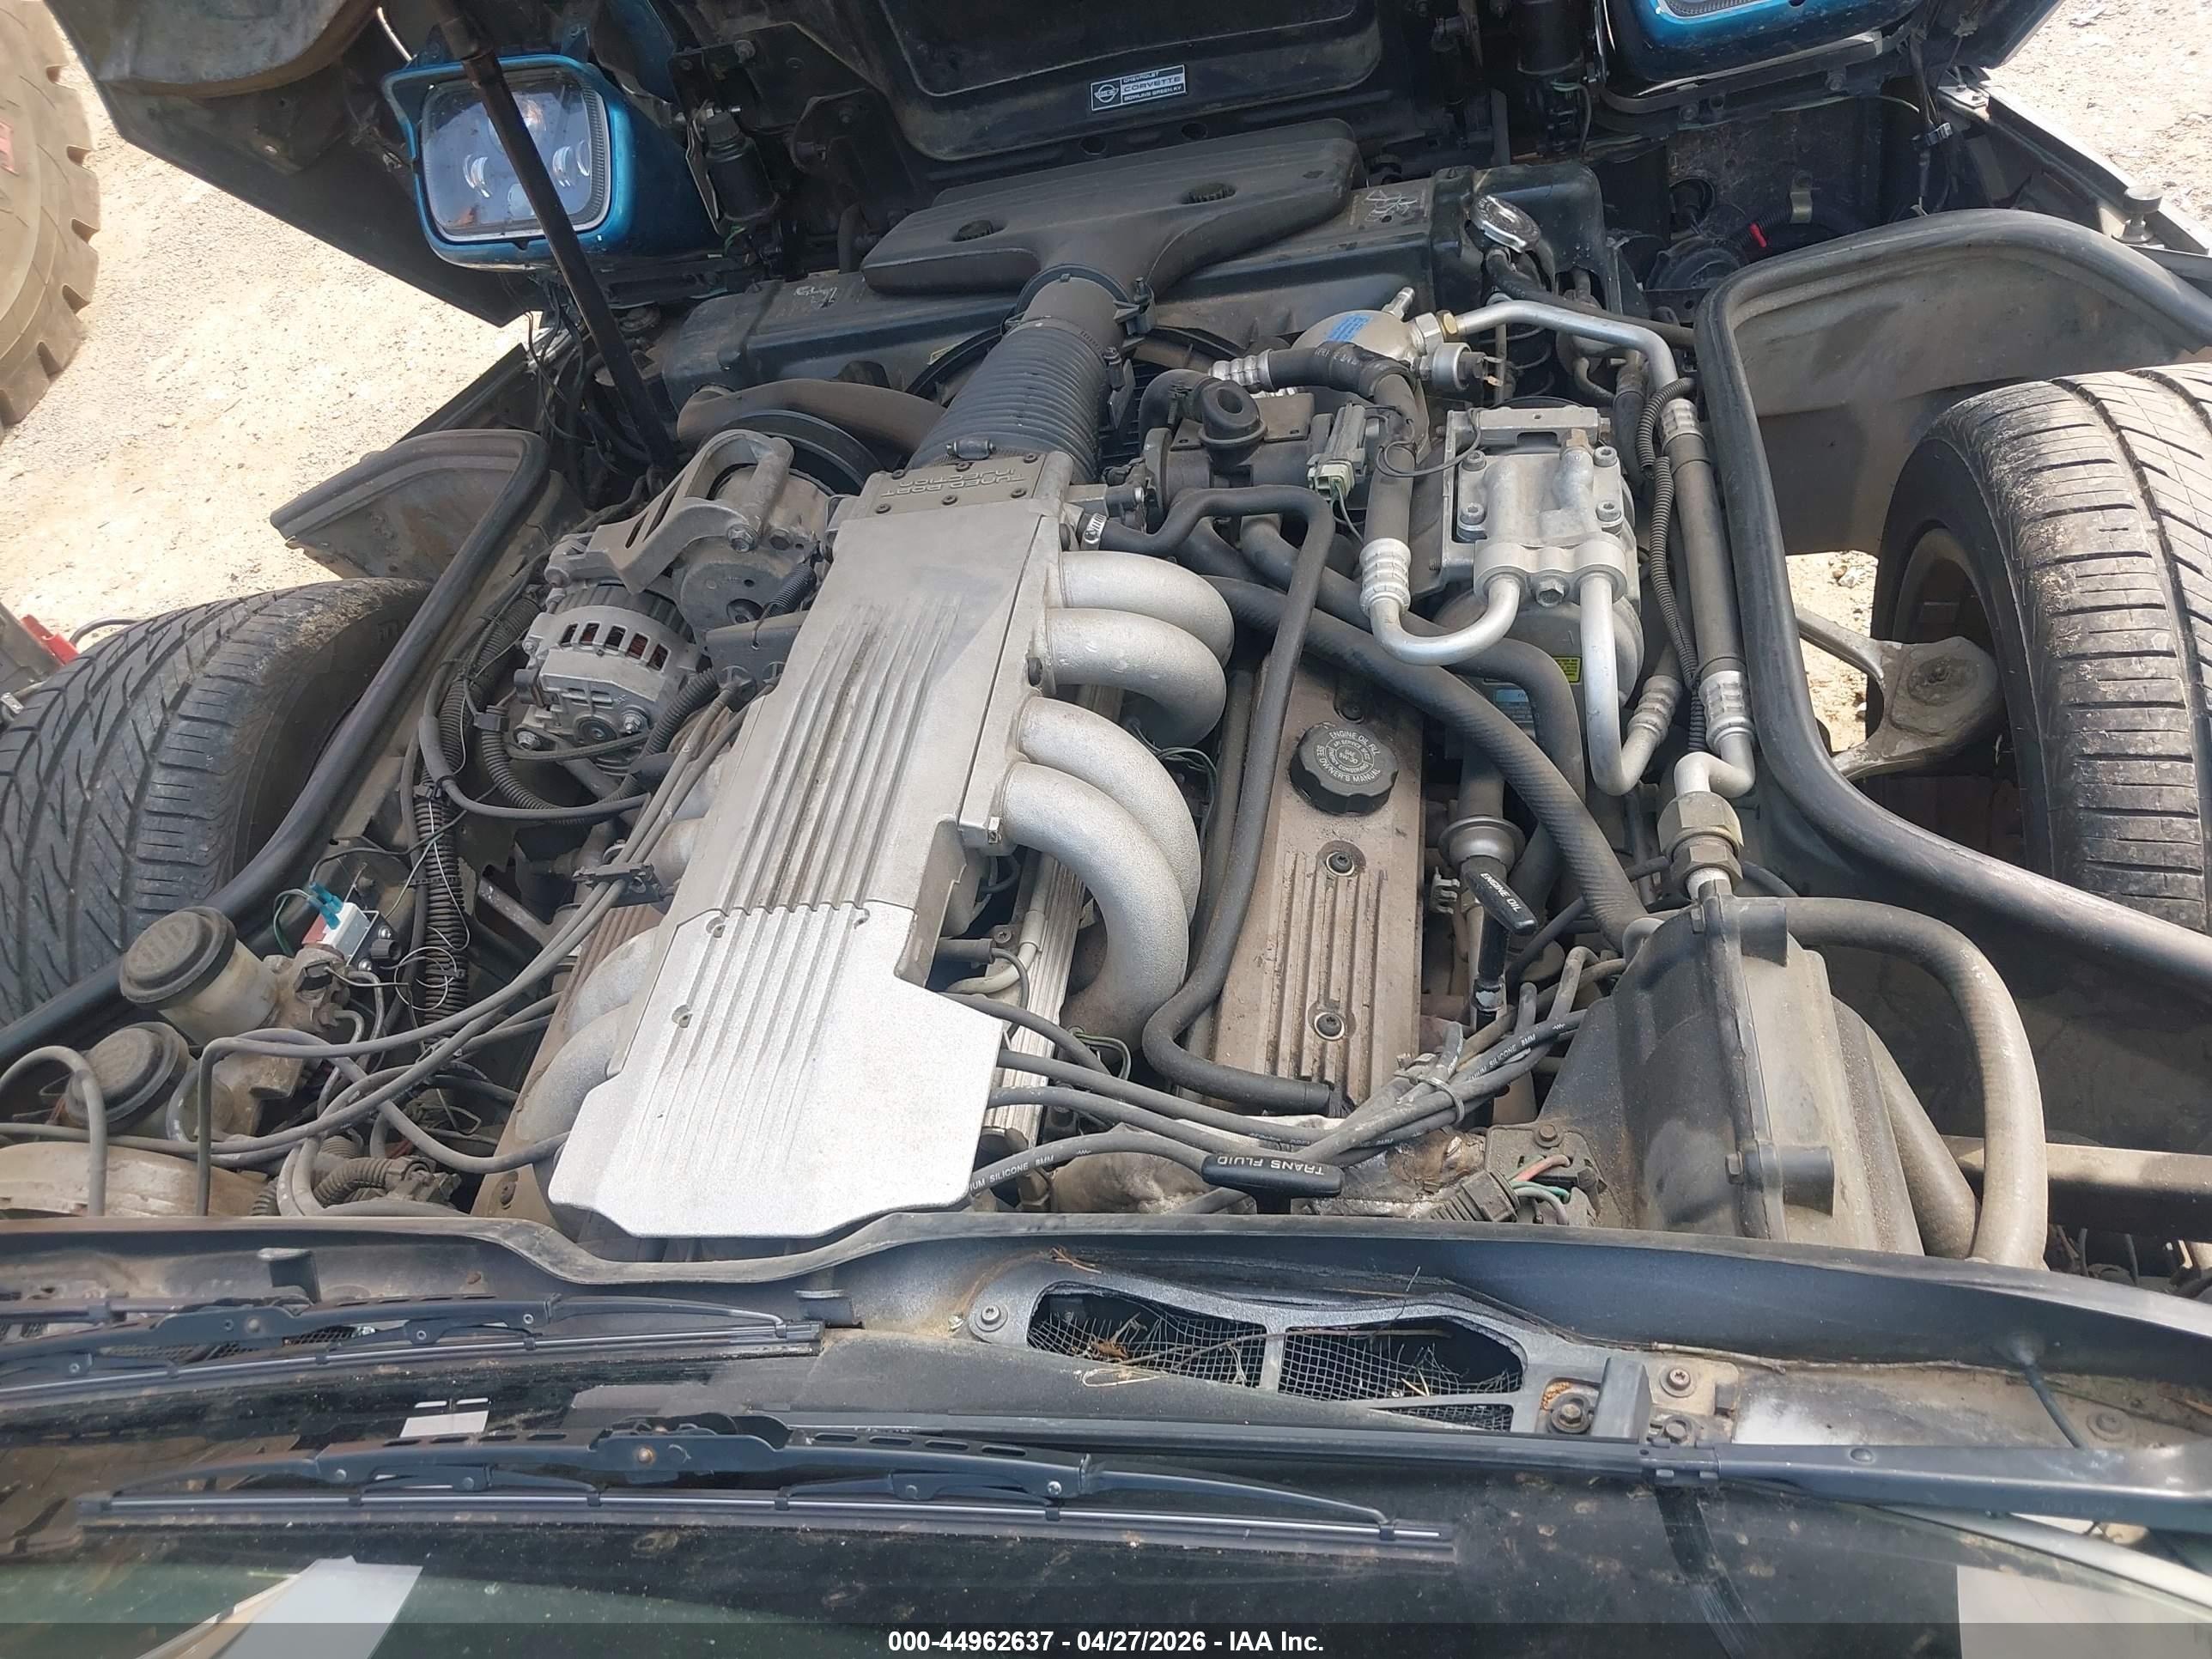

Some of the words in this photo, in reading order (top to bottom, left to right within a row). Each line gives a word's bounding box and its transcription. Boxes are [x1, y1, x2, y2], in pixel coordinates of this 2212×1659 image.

[1123, 71, 1159, 82] CHEVROLET
[1123, 76, 1181, 91] CORVETTE
[900, 468, 1016, 487] INJECTION
[950, 473, 1026, 488] TUNED
[880, 483, 943, 497] PORT
[1329, 730, 1357, 738] ENGINE
[1358, 735, 1370, 744] OIL
[1369, 744, 1382, 755] FILL
[1339, 753, 1358, 764] 5W-30
[1319, 758, 1351, 781] OWNER'S
[1352, 769, 1381, 782] MANUAL
[1480, 872, 1510, 897] ENGINE
[1506, 898, 1523, 913] OIL
[1489, 1043, 1517, 1068] SILICONE
[1521, 1033, 1536, 1046] 8MM
[989, 1162, 1029, 1183] SILICONE
[1035, 1155, 1054, 1166] 8MM
[1217, 1156, 1264, 1167] FLUID
[1270, 1159, 1324, 1176] TRANS
